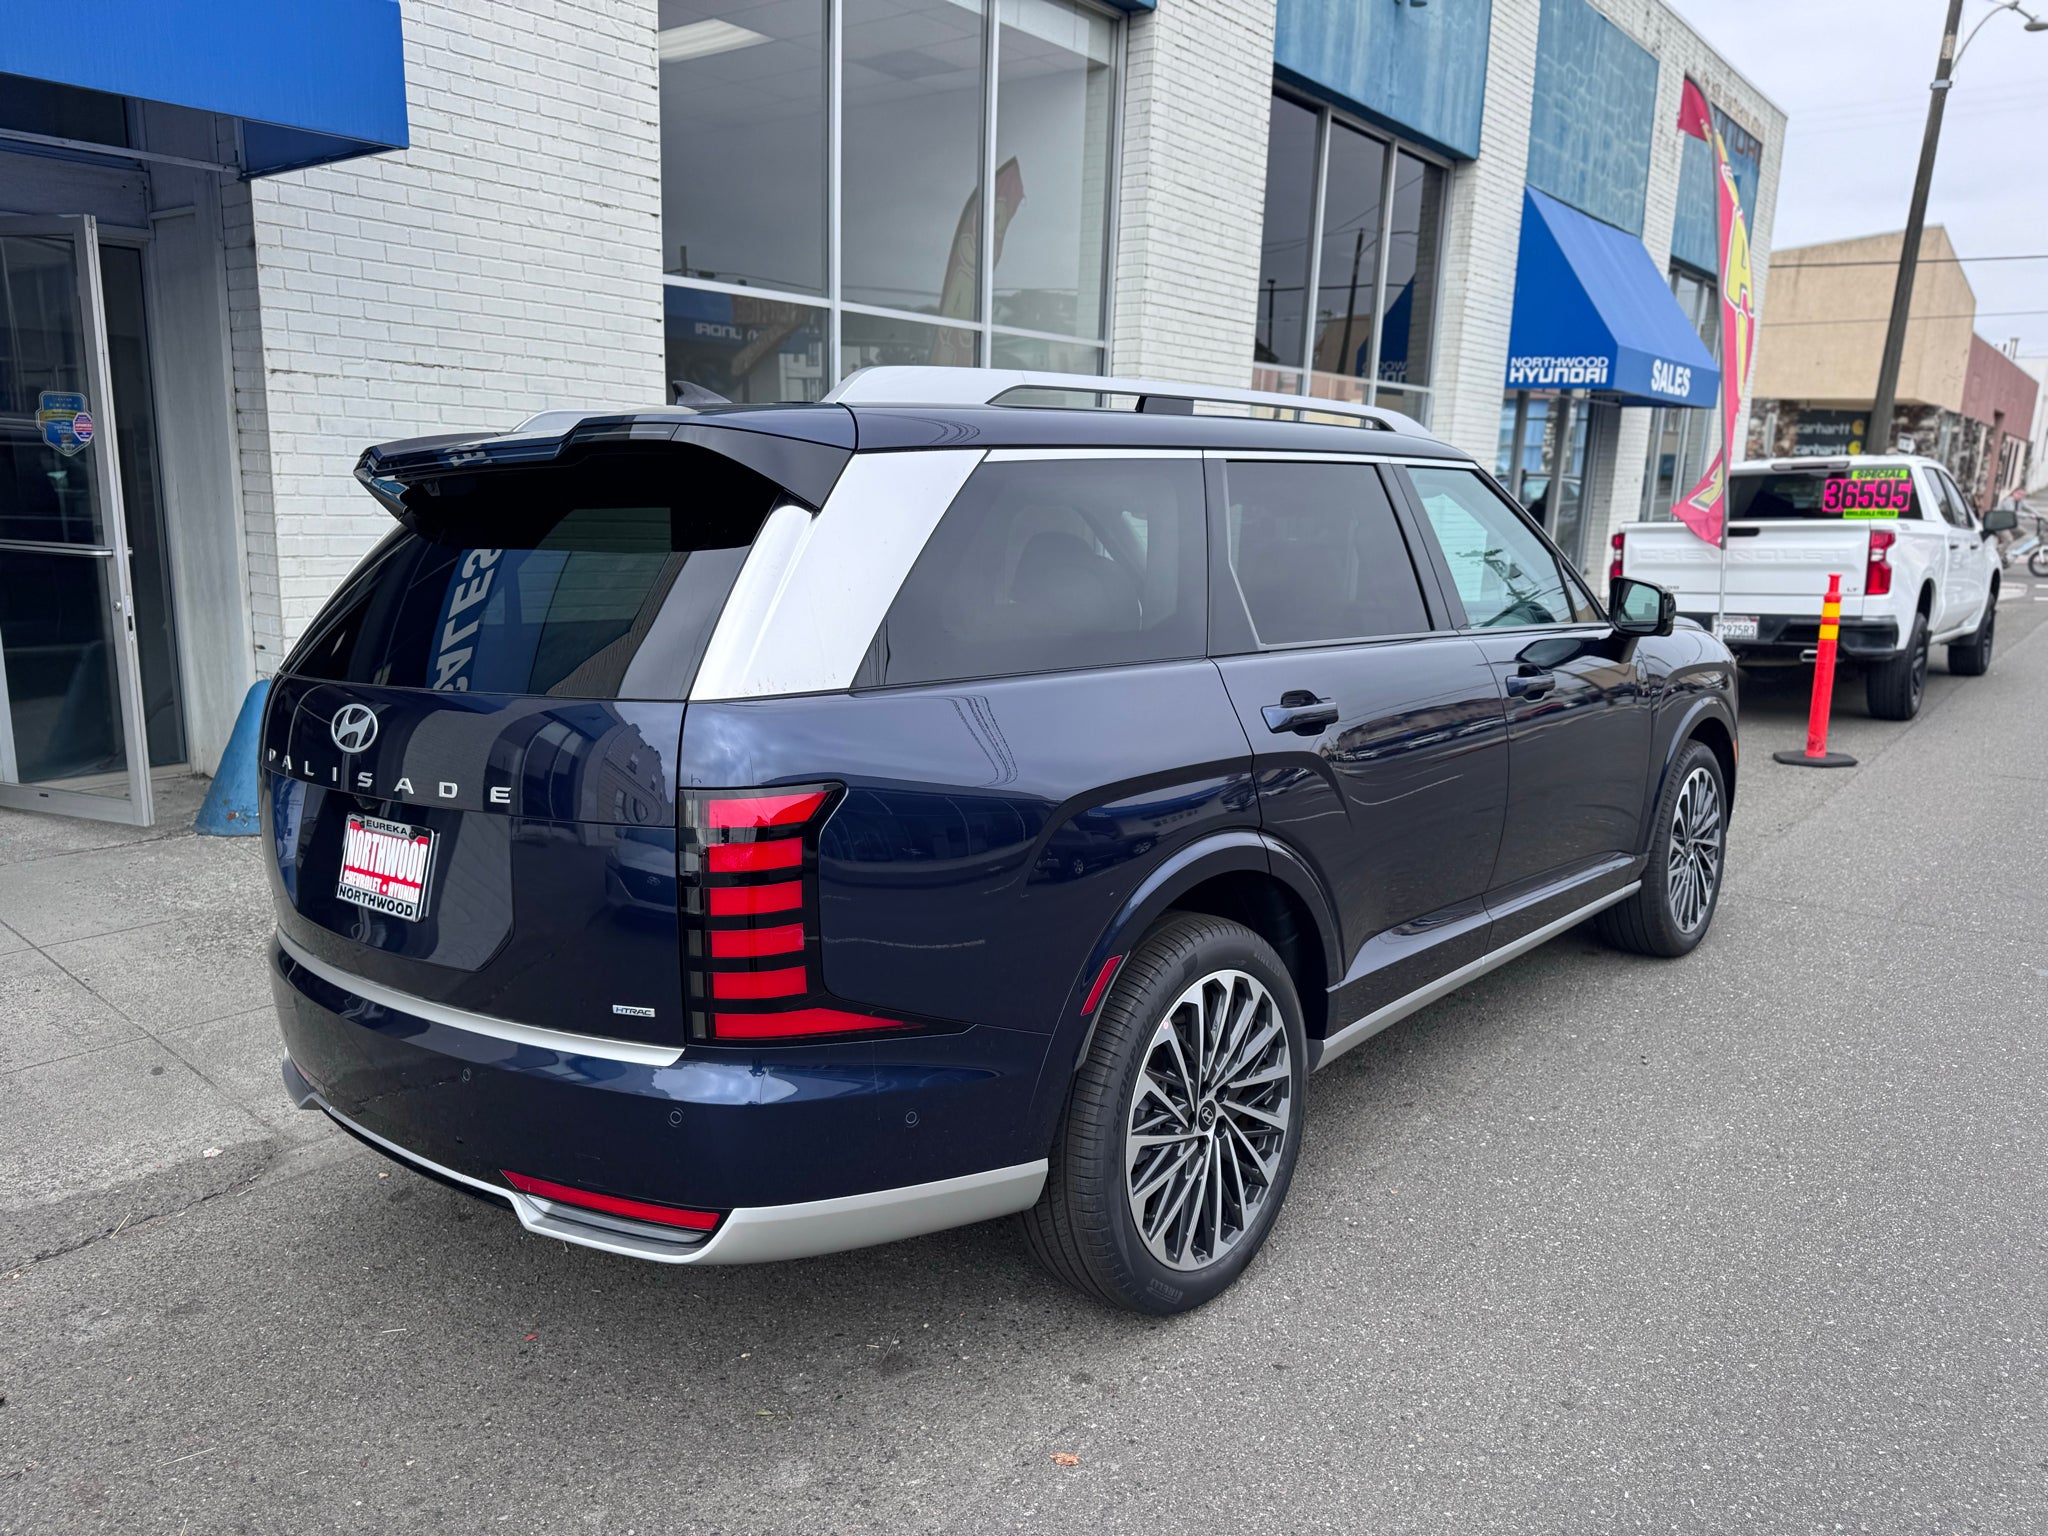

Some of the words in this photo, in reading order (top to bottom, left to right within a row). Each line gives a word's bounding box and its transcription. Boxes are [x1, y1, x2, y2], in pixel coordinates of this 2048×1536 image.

[1510, 356, 1609, 368] NORTHWOOD
[1508, 367, 1609, 384] HYUNDAI
[1650, 358, 1691, 398] SALES
[1796, 422, 1850, 435] carhartt
[1794, 440, 1847, 456] carhartt
[1857, 469, 1902, 479] SPECIAL
[1824, 479, 1911, 511] 36595
[1638, 548, 1850, 563] CHEVROLET
[268, 747, 512, 804] PALISADE
[366, 819, 408, 836] EUREKA
[345, 828, 428, 884] NORTHWOOD
[343, 869, 382, 894] CHEVROLET
[387, 881, 420, 903] HYUNDA
[338, 884, 414, 917] NORTHWOOD
[615, 1006, 653, 1016] HTRAC
